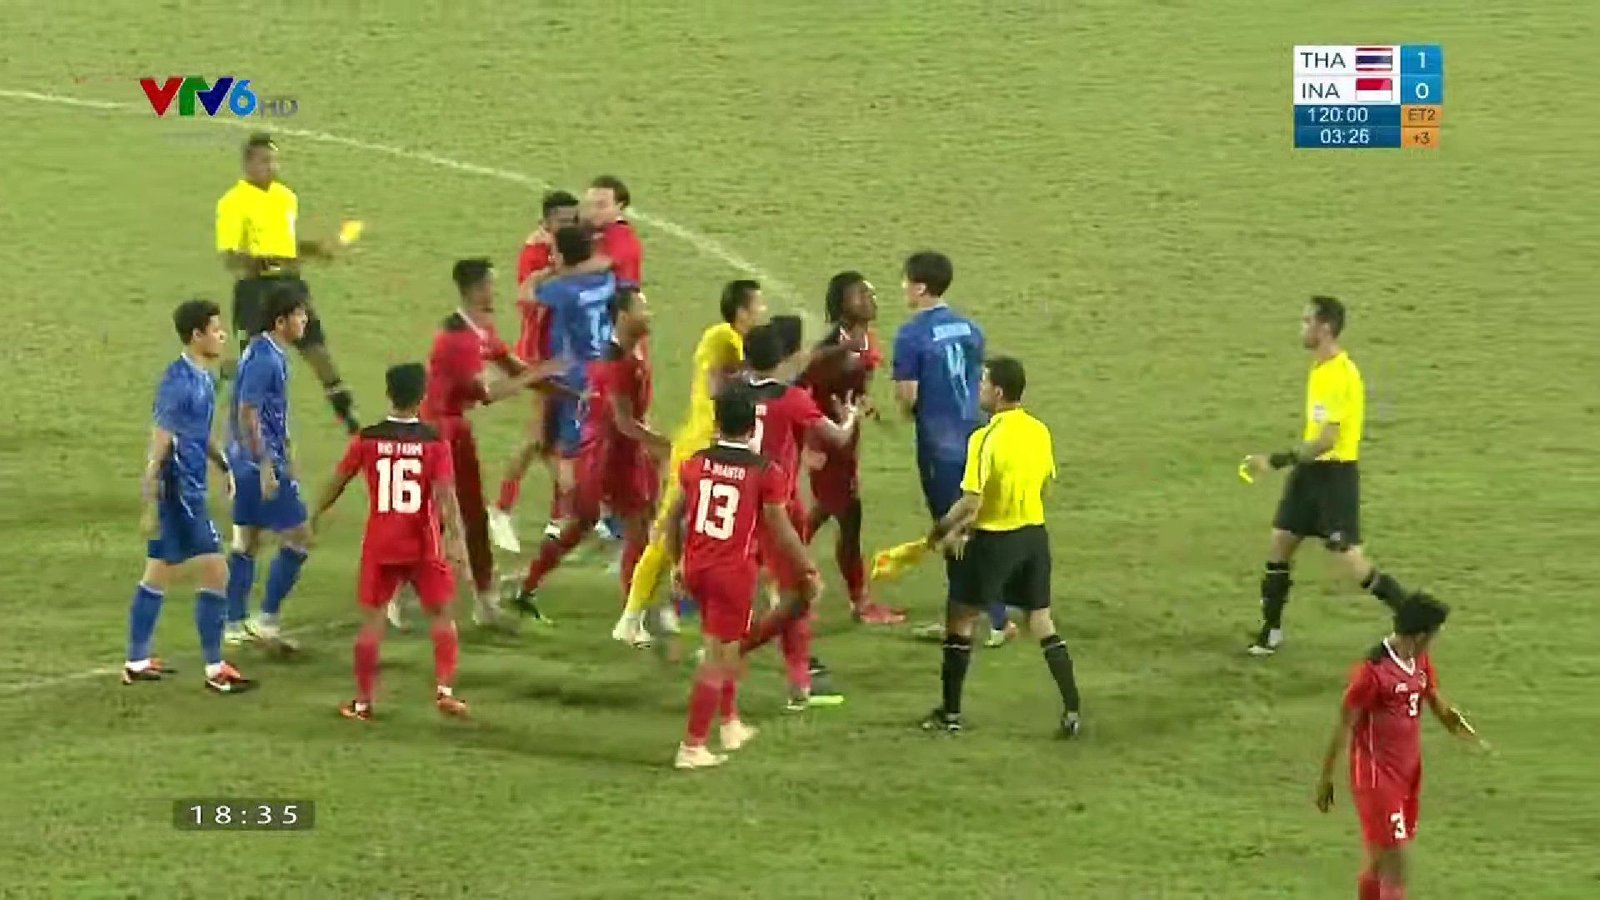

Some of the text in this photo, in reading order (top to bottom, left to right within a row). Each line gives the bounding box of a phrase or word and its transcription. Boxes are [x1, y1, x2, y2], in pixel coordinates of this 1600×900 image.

[376, 458, 422, 513] 16
[695, 479, 740, 540] 13
[1407, 693, 1419, 716] 3
[1390, 812, 1406, 839] 3
